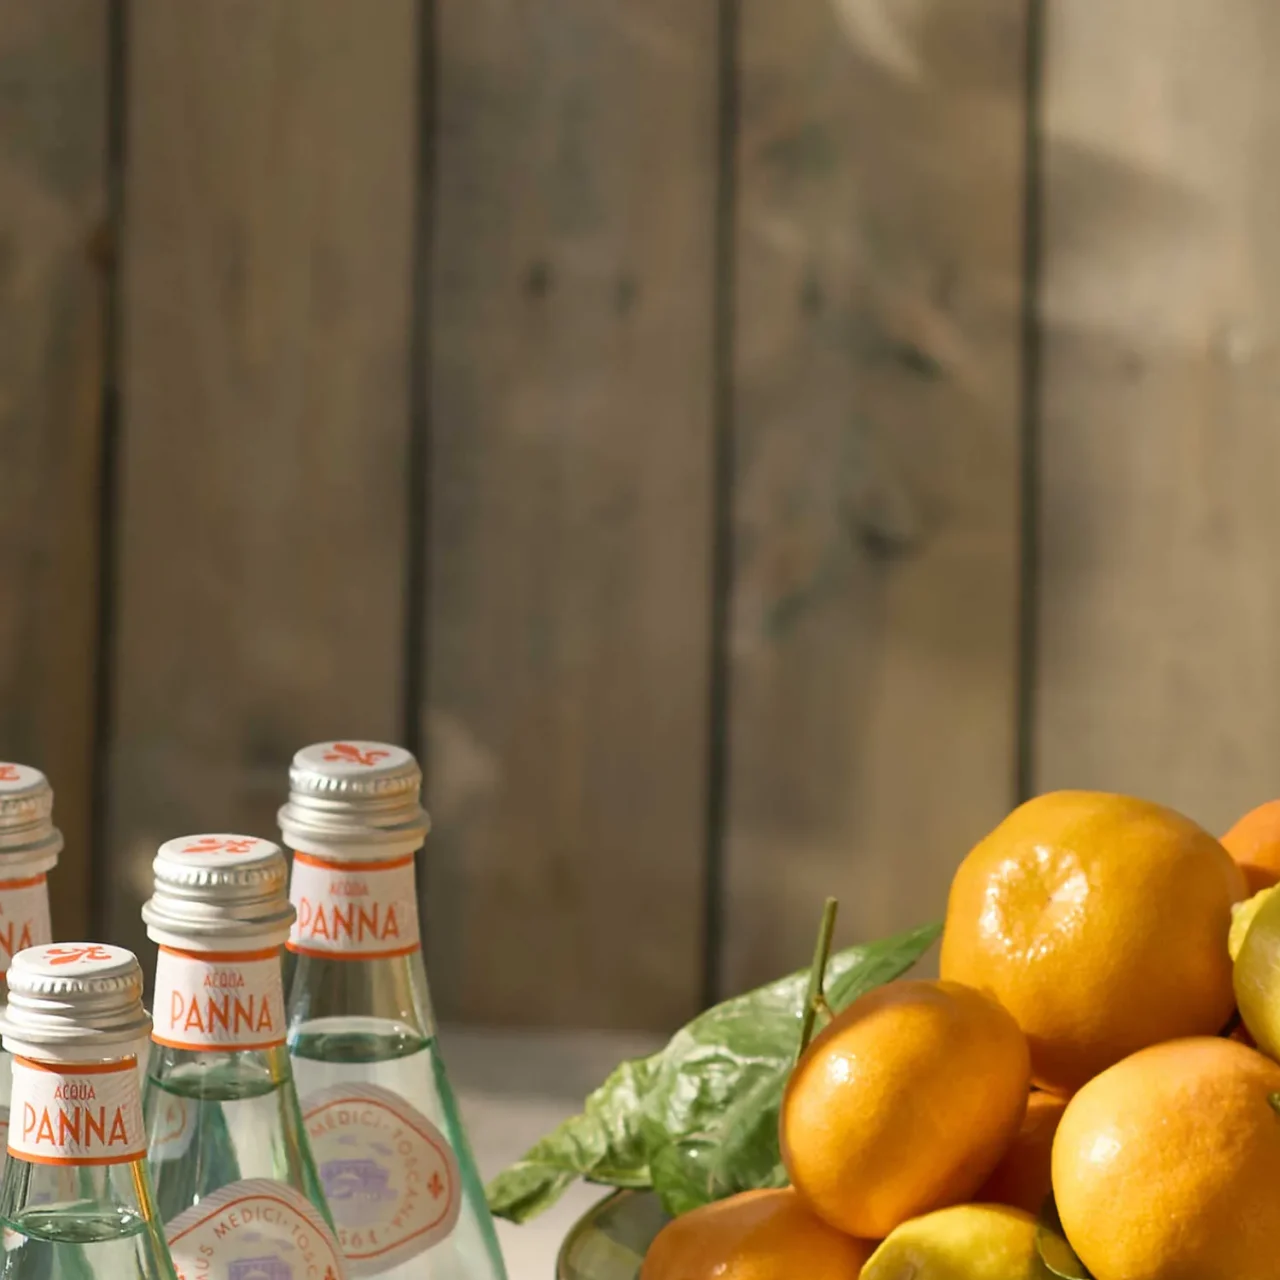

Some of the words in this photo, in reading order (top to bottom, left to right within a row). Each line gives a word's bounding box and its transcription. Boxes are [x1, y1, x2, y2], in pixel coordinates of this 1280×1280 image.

[329, 880, 369, 897] ACQUA
[299, 897, 400, 942] PANNA
[203, 970, 245, 989] ACQUA
[170, 989, 274, 1034] PANNA
[54, 1083, 96, 1100] ACQUA
[23, 1101, 129, 1147] PANNA
[213, 1206, 281, 1239] MEDICI
